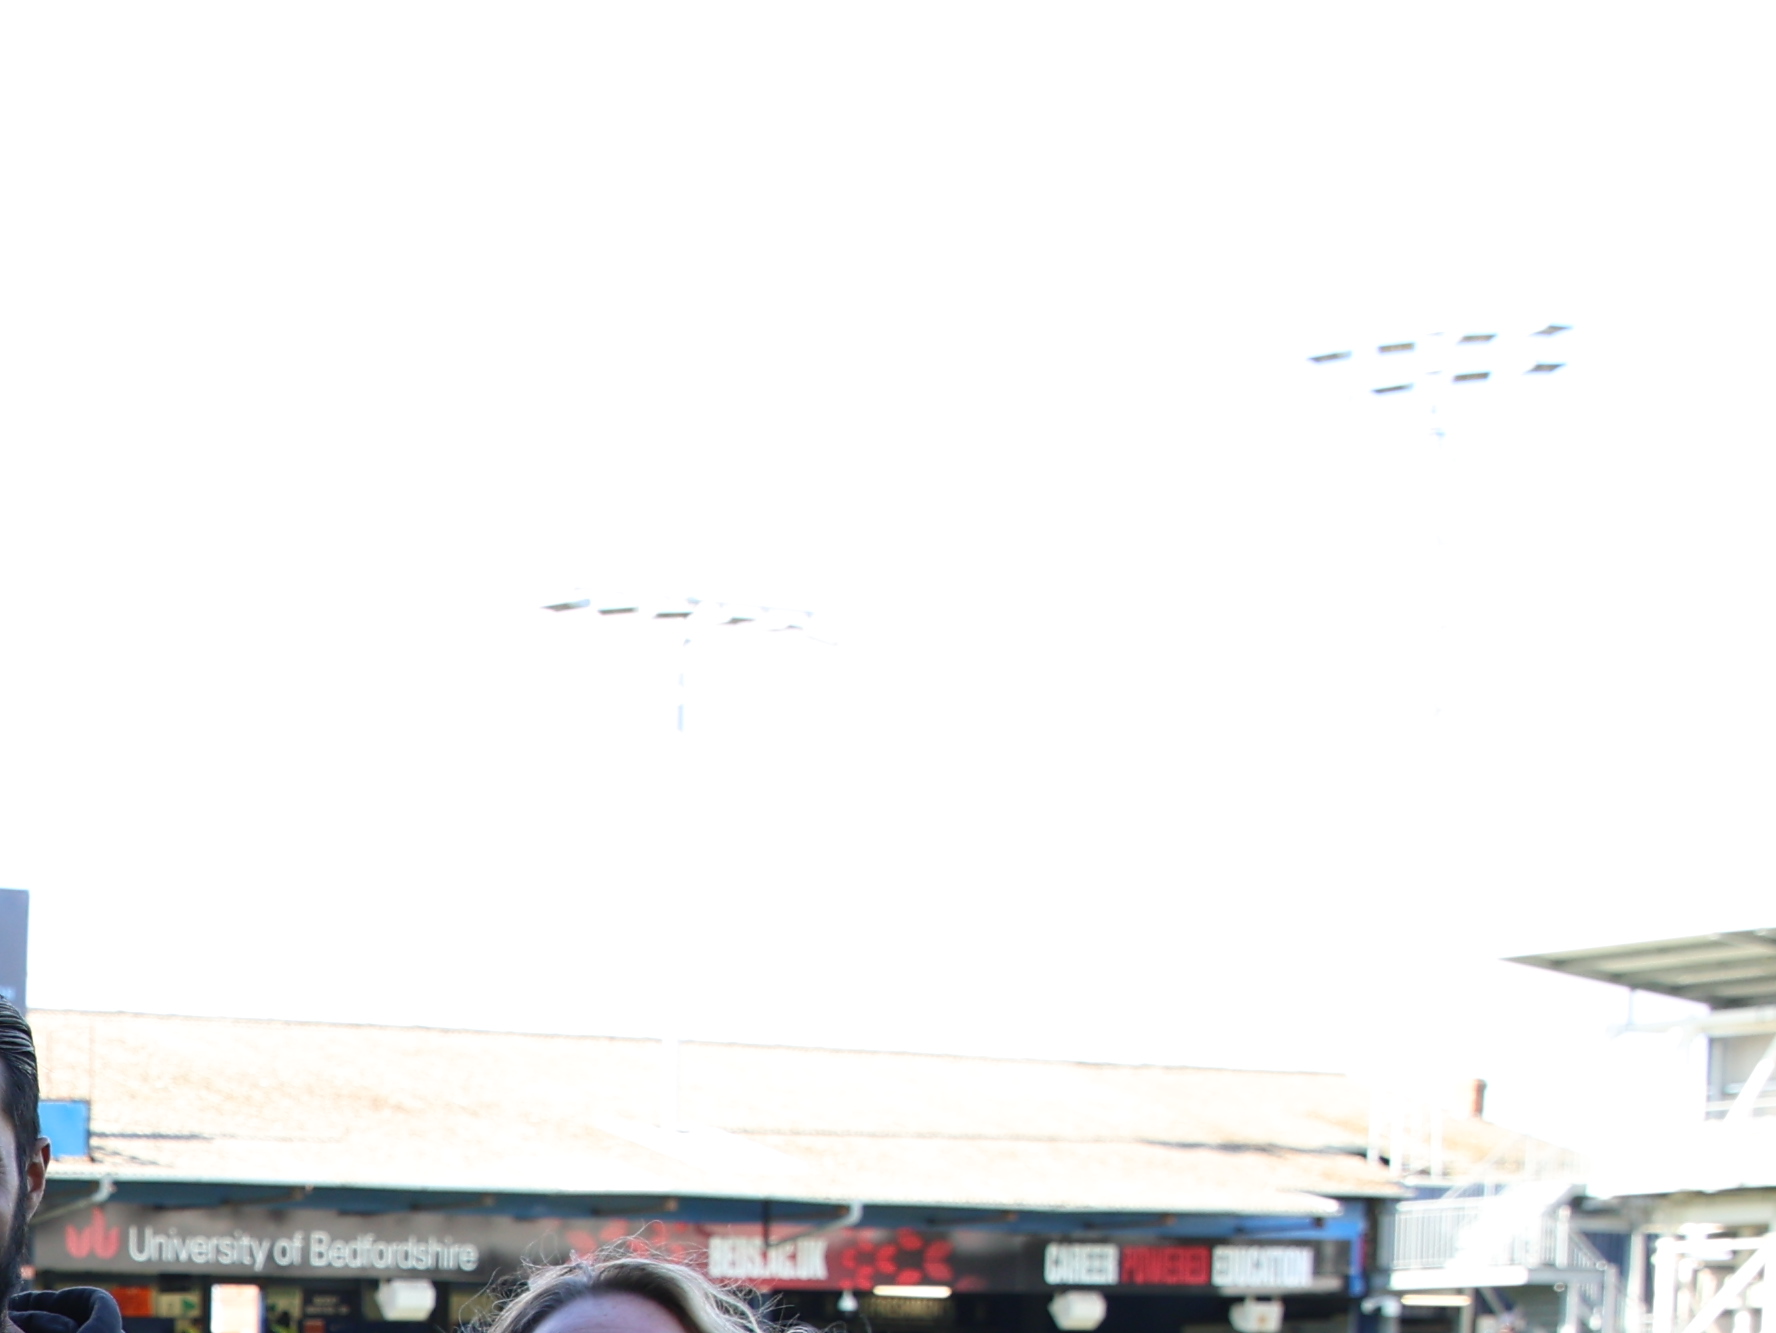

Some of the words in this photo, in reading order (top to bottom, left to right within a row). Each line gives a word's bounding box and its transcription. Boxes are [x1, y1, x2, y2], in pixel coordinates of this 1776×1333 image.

[128, 1225, 268, 1271] University
[274, 1230, 306, 1263] of
[310, 1233, 479, 1271] Bedfordshire
